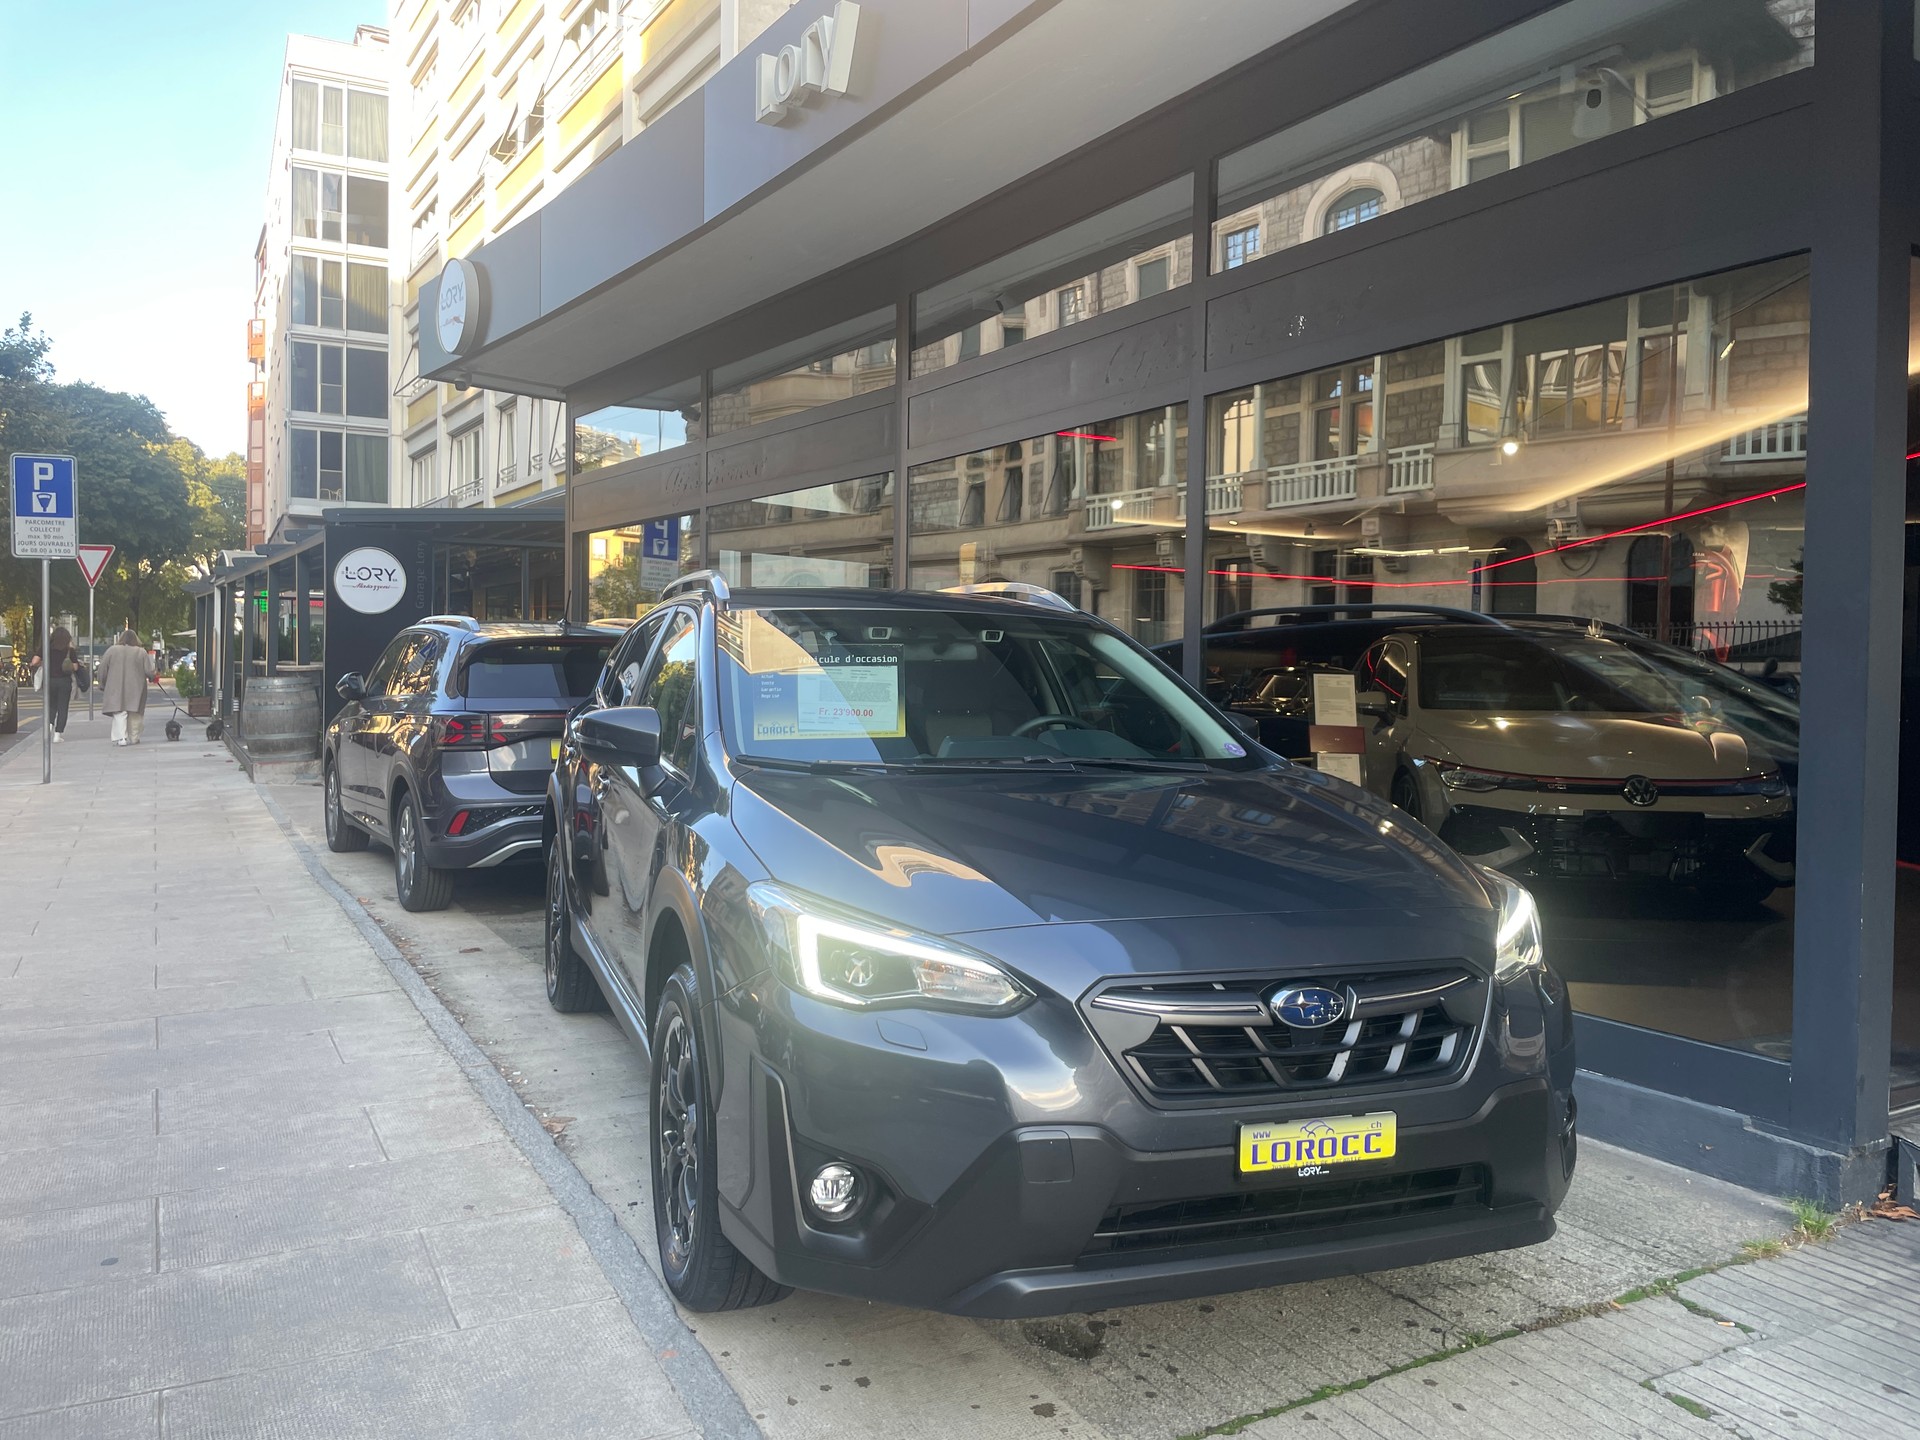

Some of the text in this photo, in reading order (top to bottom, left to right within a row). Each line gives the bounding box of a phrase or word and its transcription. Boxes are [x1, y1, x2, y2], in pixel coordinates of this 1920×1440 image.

[33, 462, 54, 490] P
[345, 566, 396, 581] LORY
[415, 567, 427, 609] Garage
[845, 654, 898, 664] d'occasion
[818, 708, 830, 716] Fr.
[833, 708, 874, 717] 23'900.00
[1251, 1132, 1382, 1166] LOROCC
